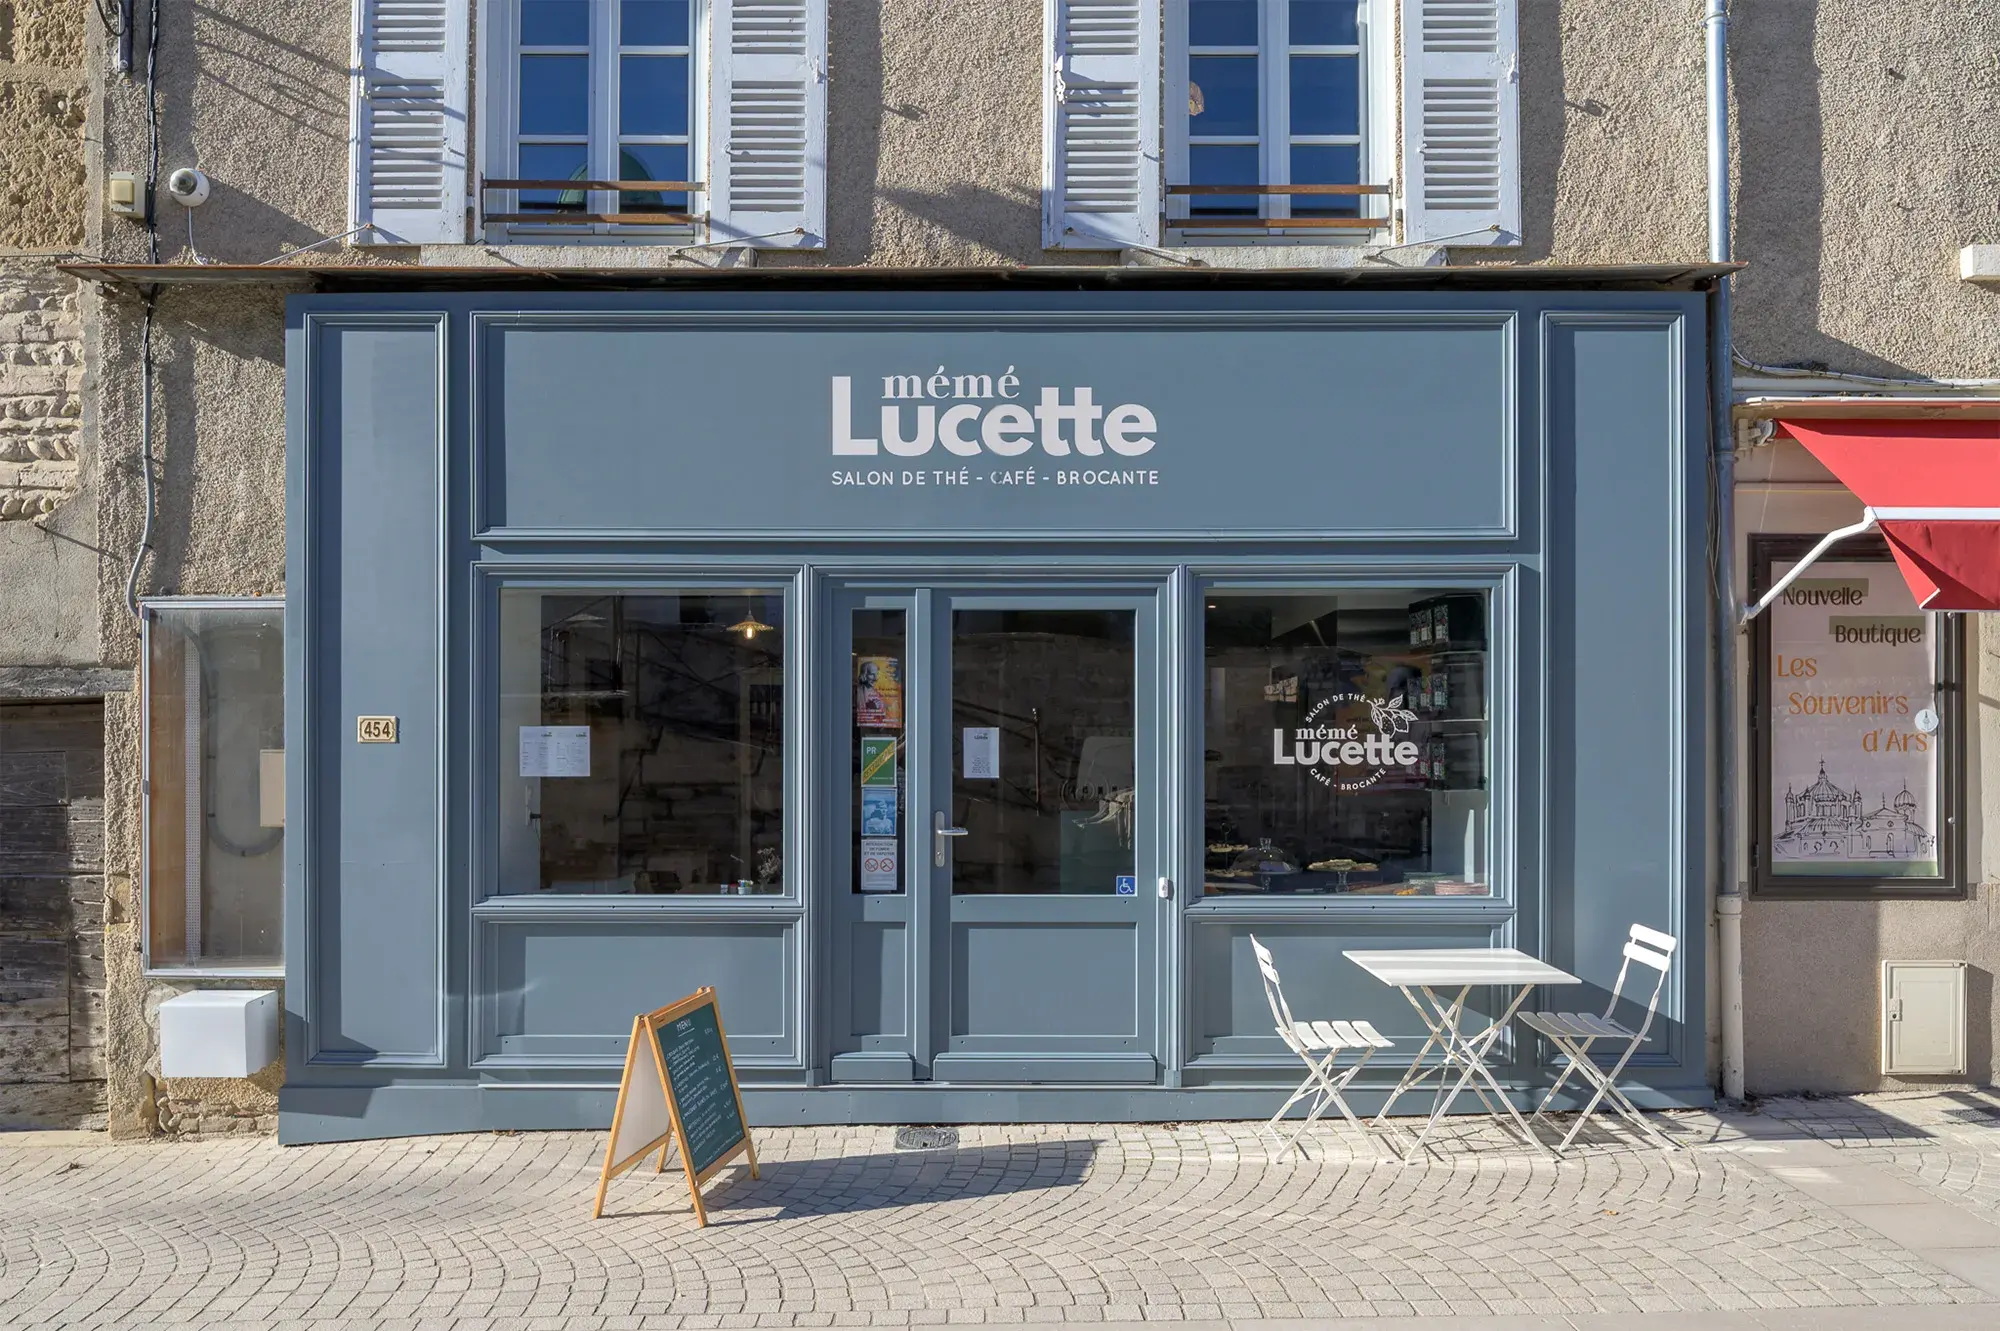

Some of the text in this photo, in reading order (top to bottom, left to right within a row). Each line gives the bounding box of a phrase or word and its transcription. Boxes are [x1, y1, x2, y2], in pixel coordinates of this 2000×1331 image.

[881, 365, 1020, 399] mémé
[832, 376, 1157, 456] Lucette
[832, 470, 894, 485] SALON
[902, 470, 926, 485] DE
[933, 466, 969, 485] THÉ
[990, 466, 1036, 485] CAFÉ
[1057, 470, 1159, 485] BROCANTE
[1782, 586, 1863, 606] Nouvelle
[1835, 624, 1921, 646] Boutique
[1777, 654, 1817, 678] Les
[1305, 692, 1366, 724] SALON DE THÉ
[1788, 691, 1909, 715] Souvenirs
[364, 721, 391, 738] 454
[1295, 724, 1359, 740] mémé
[1862, 729, 1928, 753] d'Ars
[866, 746, 877, 755] PR
[1273, 728, 1419, 766] Lucette
[1310, 768, 1331, 787] CAFÉ
[1341, 767, 1387, 791] BROCANTE
